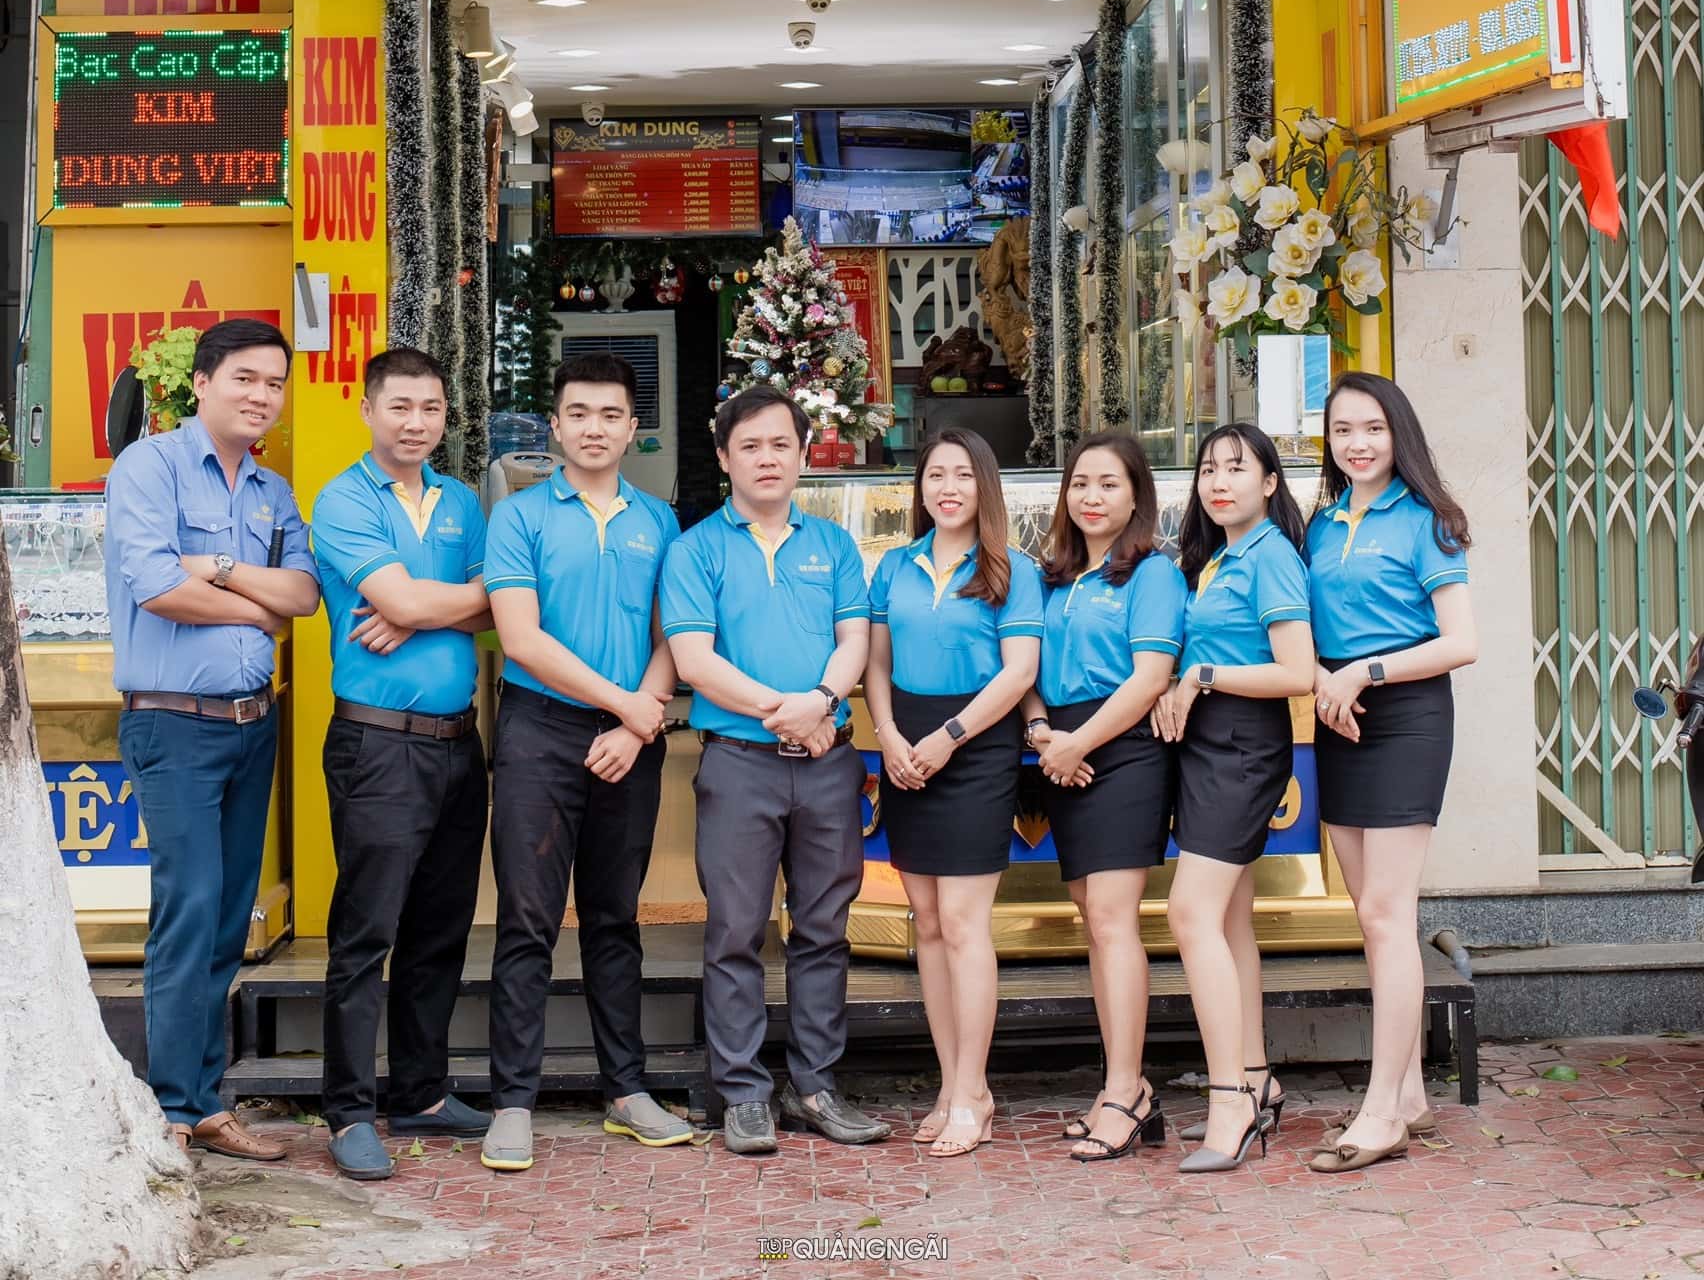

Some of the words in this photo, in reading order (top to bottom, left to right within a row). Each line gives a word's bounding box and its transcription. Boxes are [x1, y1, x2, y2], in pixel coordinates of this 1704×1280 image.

[132, 46, 198, 76] Cao
[212, 40, 279, 82] Cấp
[303, 37, 377, 126] KIM
[134, 91, 215, 123] KIM
[600, 122, 637, 137] KIM
[644, 122, 699, 137] DUNG
[61, 154, 183, 187] DUNG
[192, 149, 281, 191] VIỆT
[303, 151, 376, 242] DUNG
